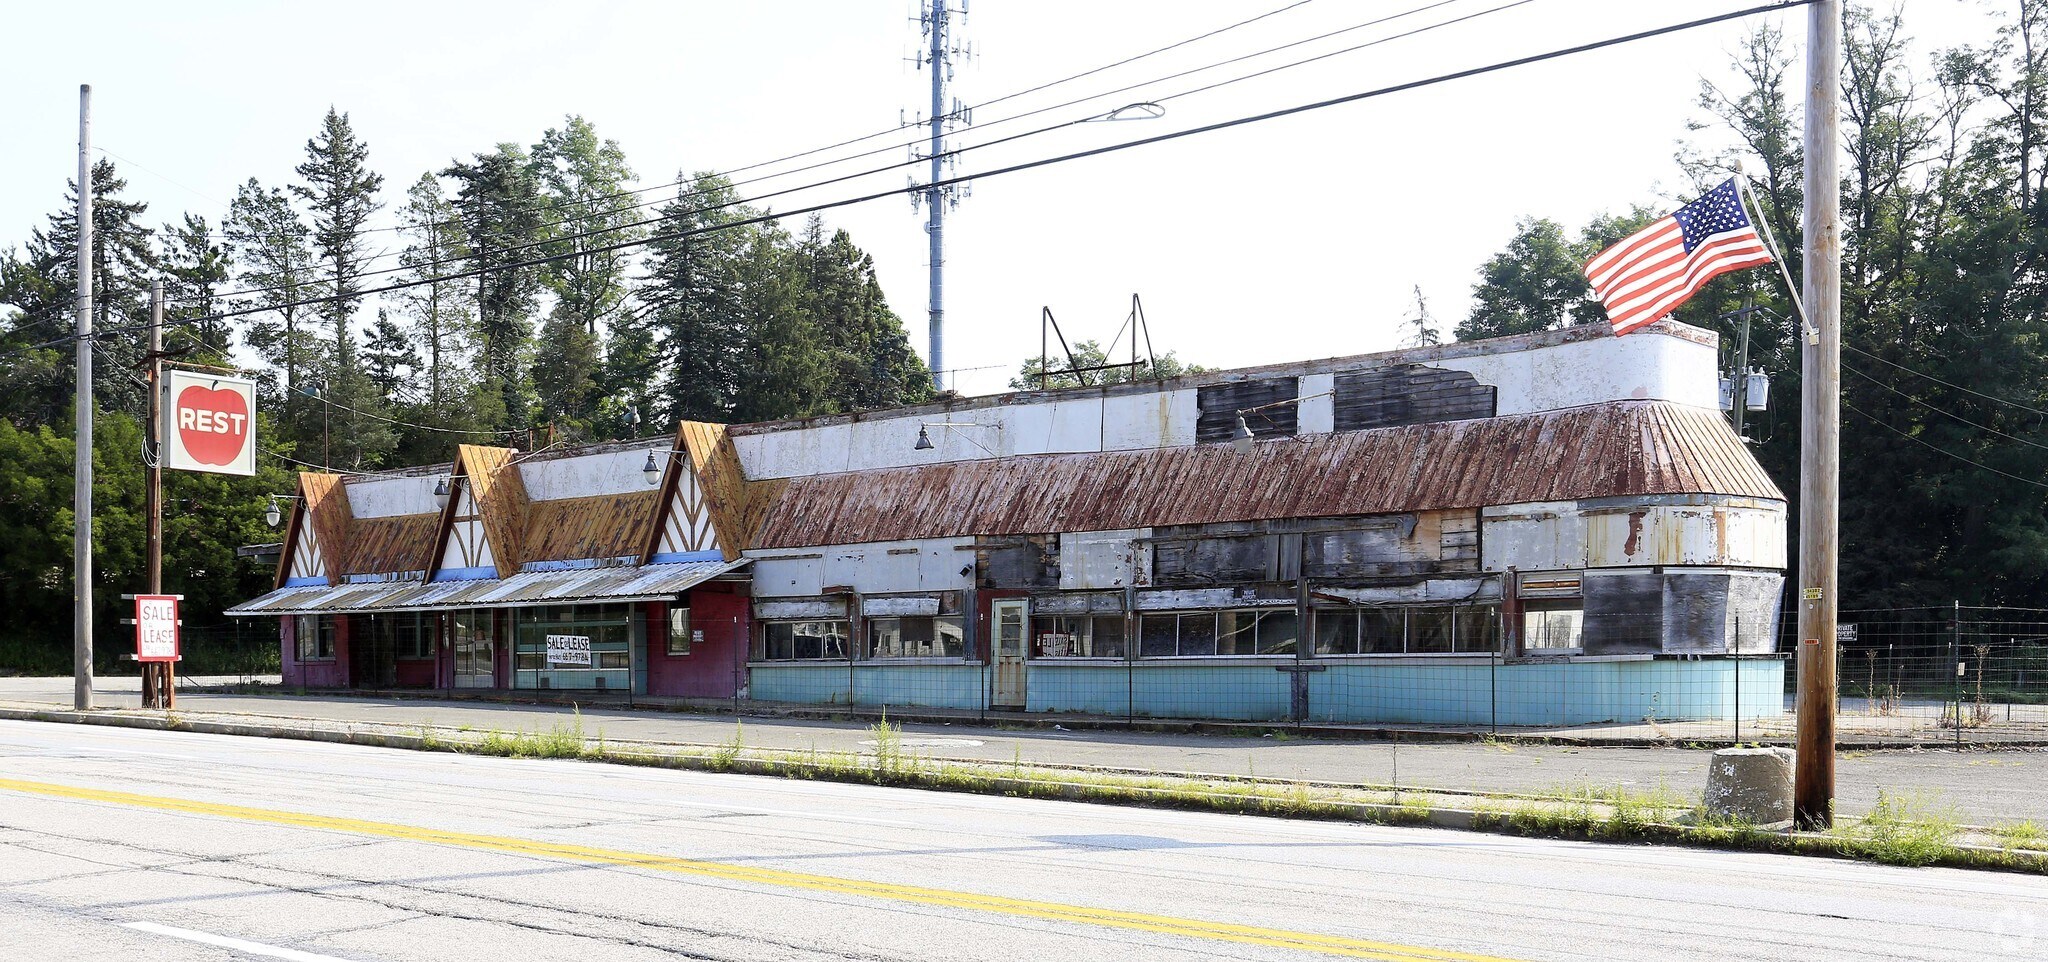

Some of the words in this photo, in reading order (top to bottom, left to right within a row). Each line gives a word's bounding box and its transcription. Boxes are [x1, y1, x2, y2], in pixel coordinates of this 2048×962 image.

[180, 407, 246, 436] REST
[143, 605, 174, 621] SALE
[143, 629, 174, 643] LEASE
[548, 636, 565, 650] SALE
[568, 637, 590, 651] LEASE
